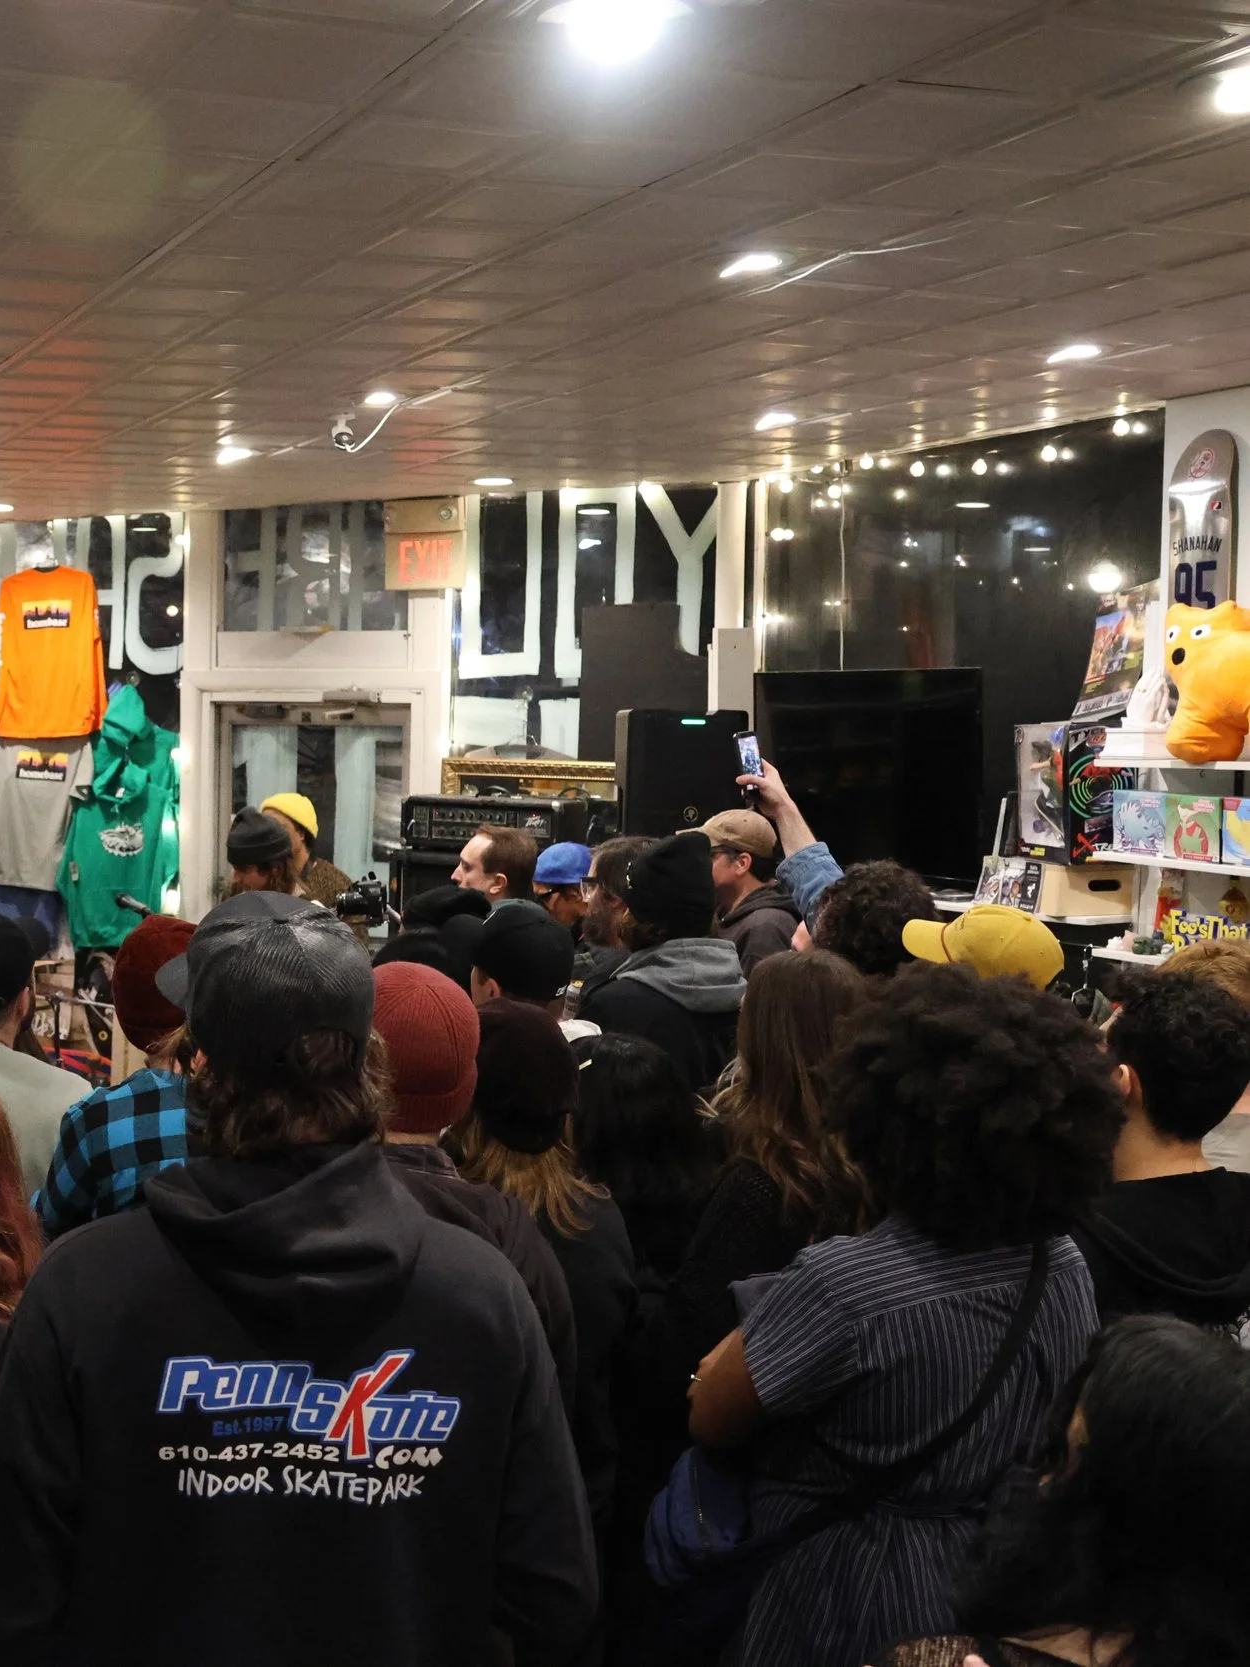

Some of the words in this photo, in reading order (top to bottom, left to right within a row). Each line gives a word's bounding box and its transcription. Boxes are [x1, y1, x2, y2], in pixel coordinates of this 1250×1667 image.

[1173, 535, 1222, 556] SHANAHAN
[398, 540, 451, 582] EXIT
[1175, 561, 1218, 609] 95
[19, 768, 64, 780] homebase
[158, 1442, 339, 1462] 610-437-2452
[178, 1466, 274, 1497] INDOOR
[283, 1464, 425, 1504] SKATEPARK
